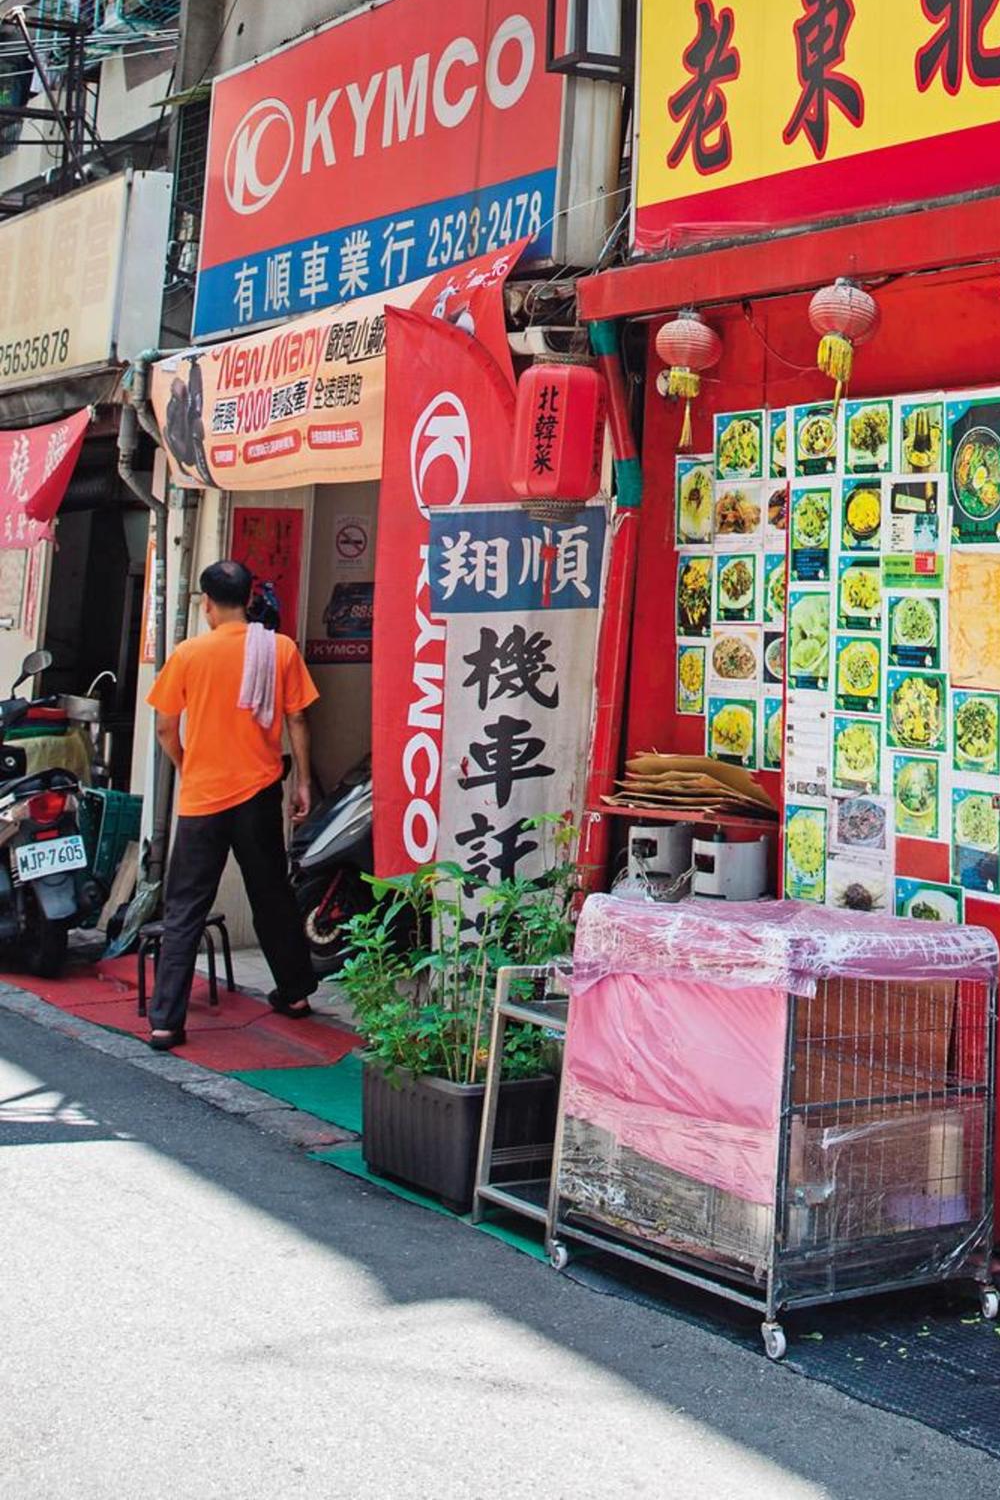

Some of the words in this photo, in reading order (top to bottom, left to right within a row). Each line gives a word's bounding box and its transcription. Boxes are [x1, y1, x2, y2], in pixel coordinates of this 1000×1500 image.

[300, 14, 536, 175] KYMCO
[232, 218, 417, 324] 有順車業行
[426, 190, 543, 268] 2523-2478
[0, 327, 71, 378] 5635878
[531, 384, 560, 476] 北韓菜
[440, 525, 594, 601] 翔順
[313, 643, 369, 655] KYMCO
[454, 624, 560, 950] 機車託
